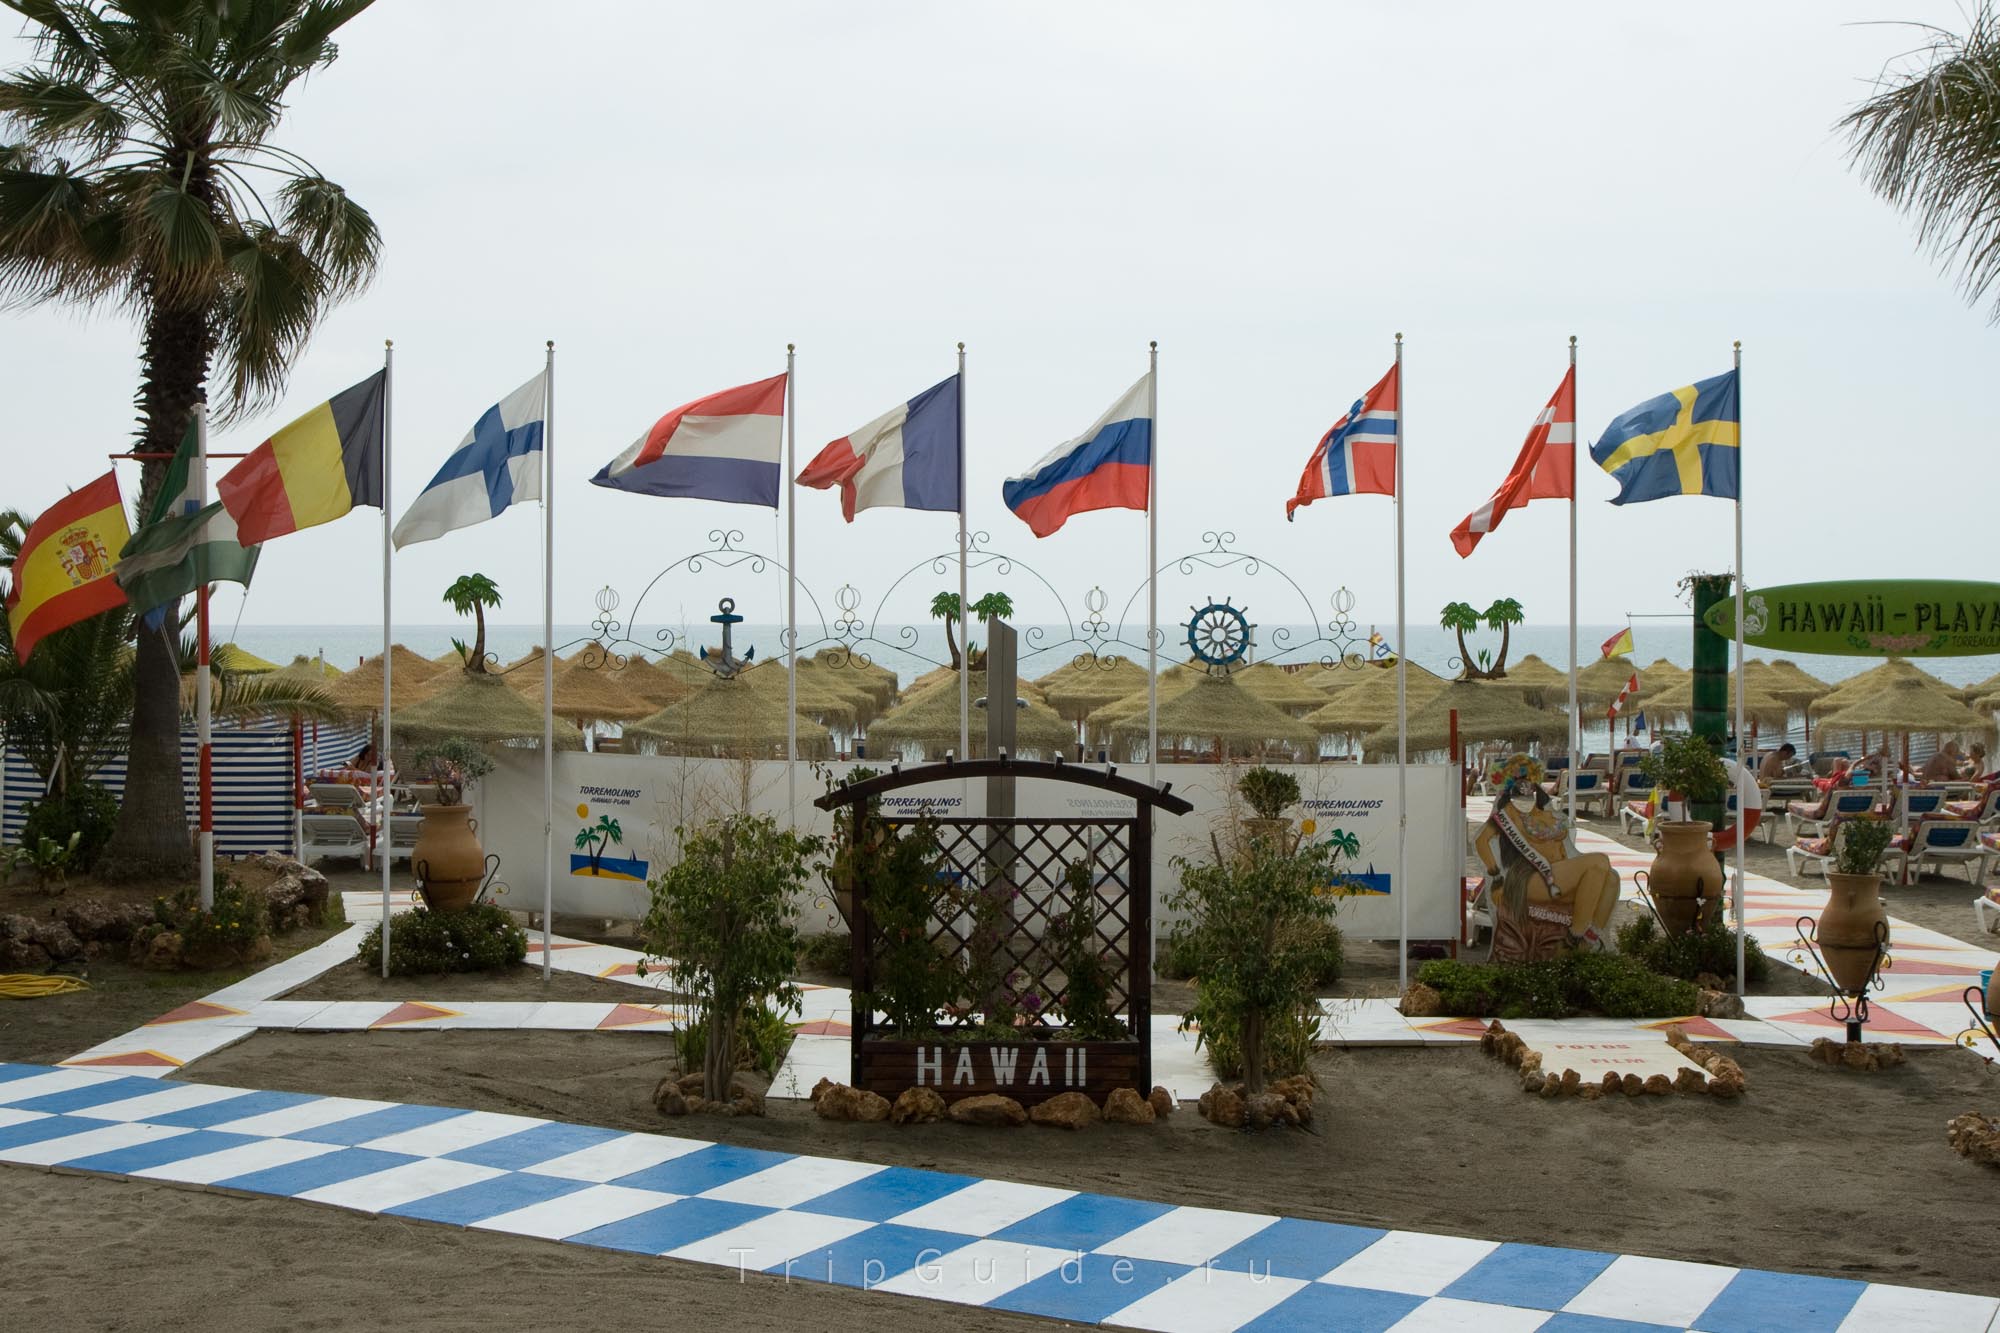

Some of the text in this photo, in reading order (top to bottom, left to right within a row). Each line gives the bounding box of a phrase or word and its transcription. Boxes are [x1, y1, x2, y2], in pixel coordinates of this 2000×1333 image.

[1914, 602, 2000, 632] PLAYA
[580, 786, 641, 798] TORREMOLINOS
[881, 797, 962, 807] TORREMOLINOS
[1302, 800, 1383, 809] TORREMOLINOS
[1527, 852, 1551, 875] PLAYA
[916, 1046, 1087, 1087] HAWAII
